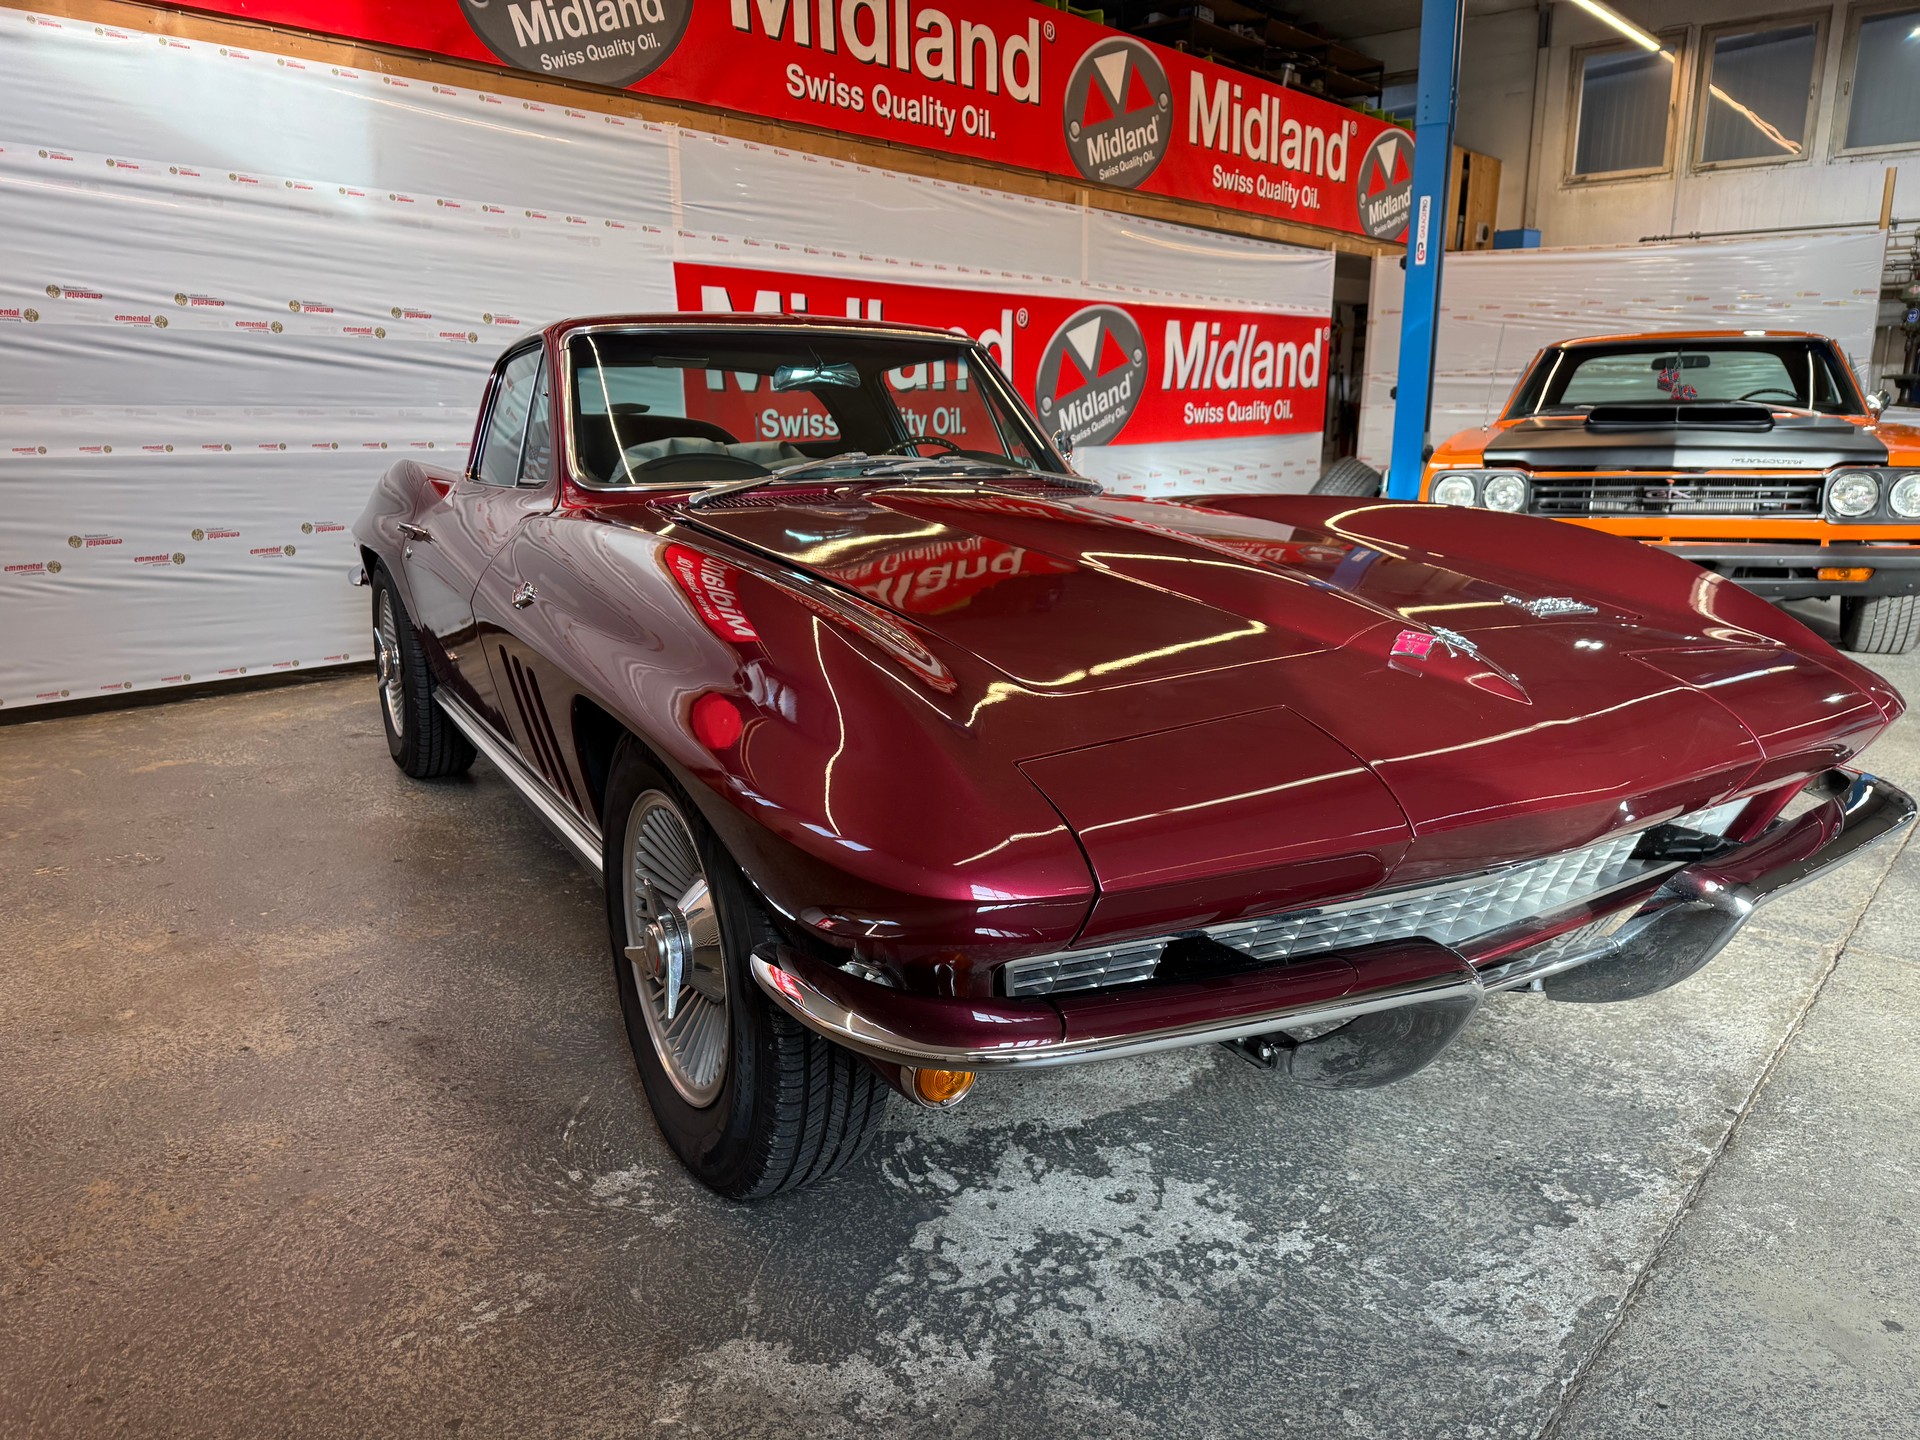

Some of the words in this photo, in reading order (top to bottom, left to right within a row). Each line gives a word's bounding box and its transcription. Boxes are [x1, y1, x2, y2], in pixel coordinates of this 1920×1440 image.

[541, 46, 586, 71] Swiss
[586, 37, 637, 62] Quality
[637, 32, 662, 51] Oil.
[786, 63, 865, 112] Swiss
[872, 84, 957, 136] Quality
[961, 105, 997, 140] Oil.
[1099, 165, 1120, 181] Swiss
[1119, 155, 1144, 172] Quality
[1212, 164, 1255, 195] Swiss
[1256, 174, 1301, 210] Quality
[1301, 185, 1321, 209] Oil.
[64, 290, 104, 300] emmental
[190, 298, 226, 307] emmental
[0, 308, 19, 317] ental
[303, 305, 334, 314] emmental
[114, 314, 151, 323] emmental
[235, 320, 268, 328] emmental
[342, 326, 372, 334] emmental
[1184, 401, 1225, 425] Swiss
[1226, 400, 1272, 425] Quality
[1273, 399, 1294, 420] Oil.
[761, 408, 839, 438] Swiss
[932, 406, 967, 436] Oil.
[1069, 426, 1092, 446] Swiss
[1091, 412, 1115, 433] Quality
[315, 525, 345, 534] emmental
[207, 531, 241, 541] emmental
[86, 538, 123, 548] emmental
[249, 546, 282, 555] emmental
[133, 553, 169, 563] emmental
[4, 562, 43, 572] emmental
